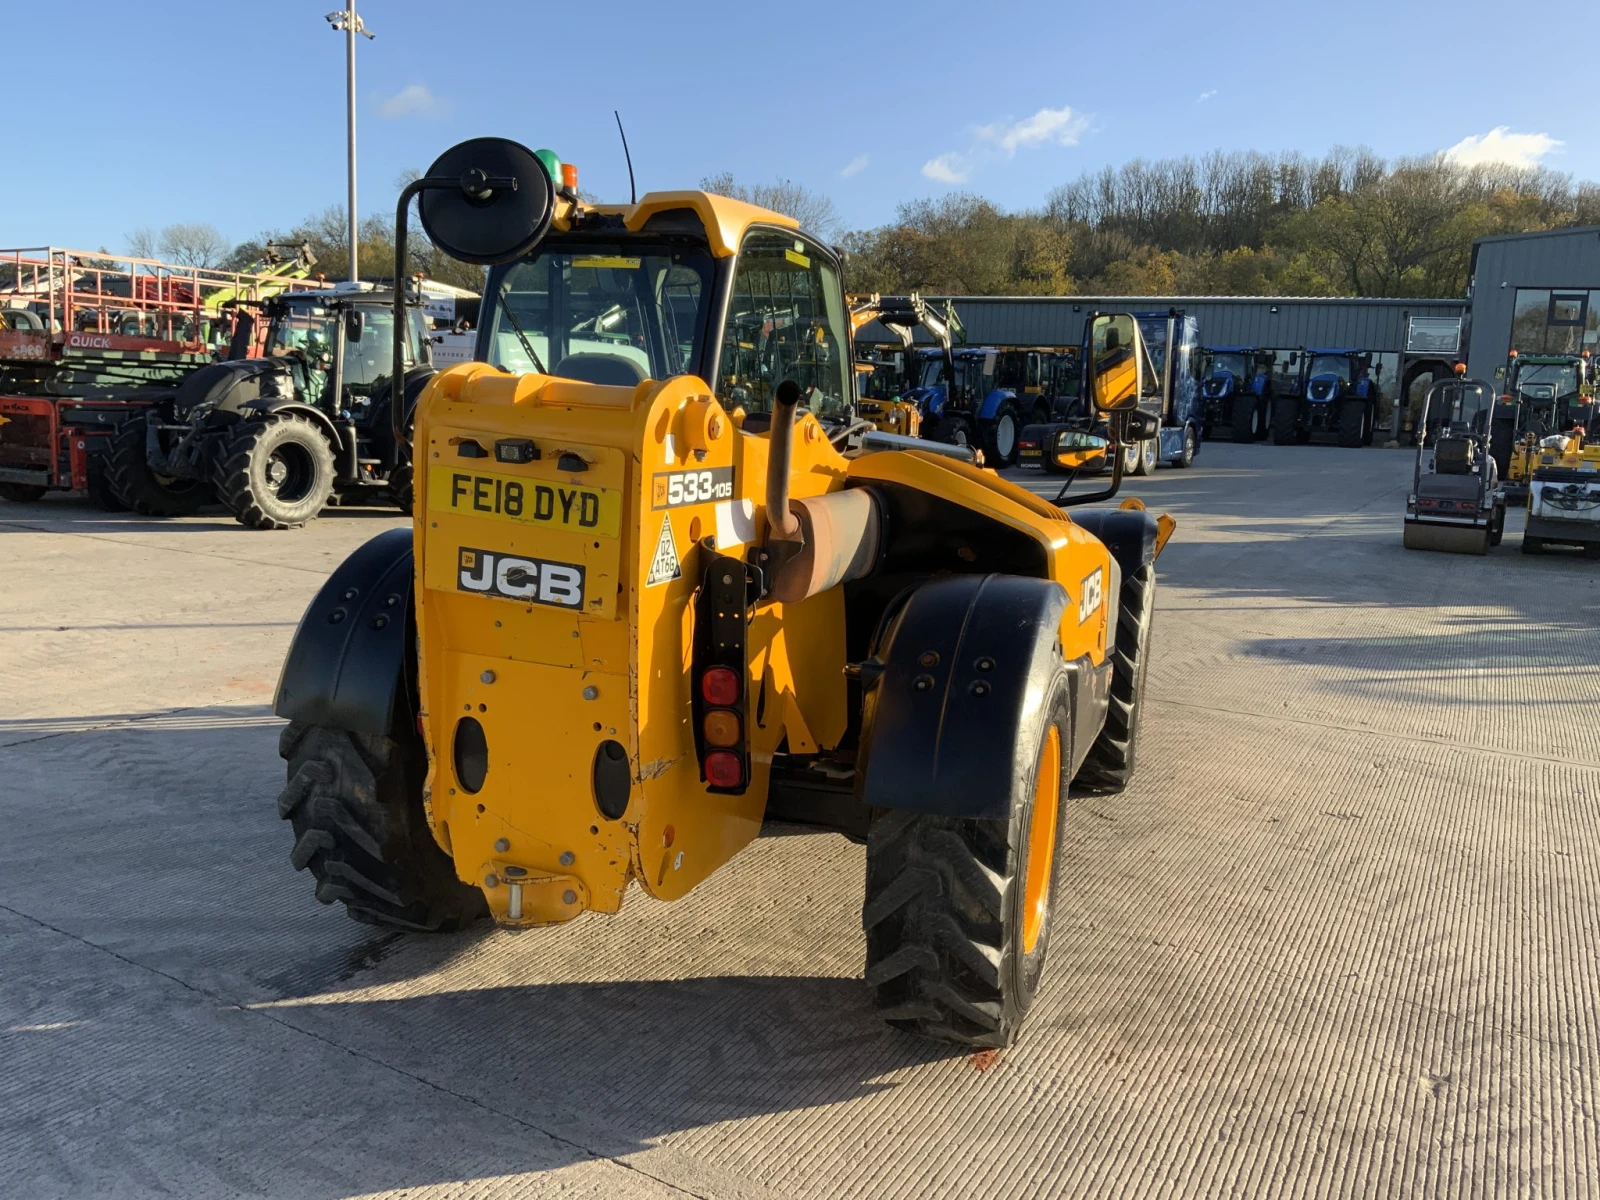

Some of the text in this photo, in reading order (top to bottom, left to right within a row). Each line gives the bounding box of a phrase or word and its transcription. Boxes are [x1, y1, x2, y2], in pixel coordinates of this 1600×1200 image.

[70, 336, 110, 348] QUICK
[451, 473, 600, 528] FE18 DYD
[460, 554, 582, 606] JCB
[1079, 569, 1102, 623] JCB
